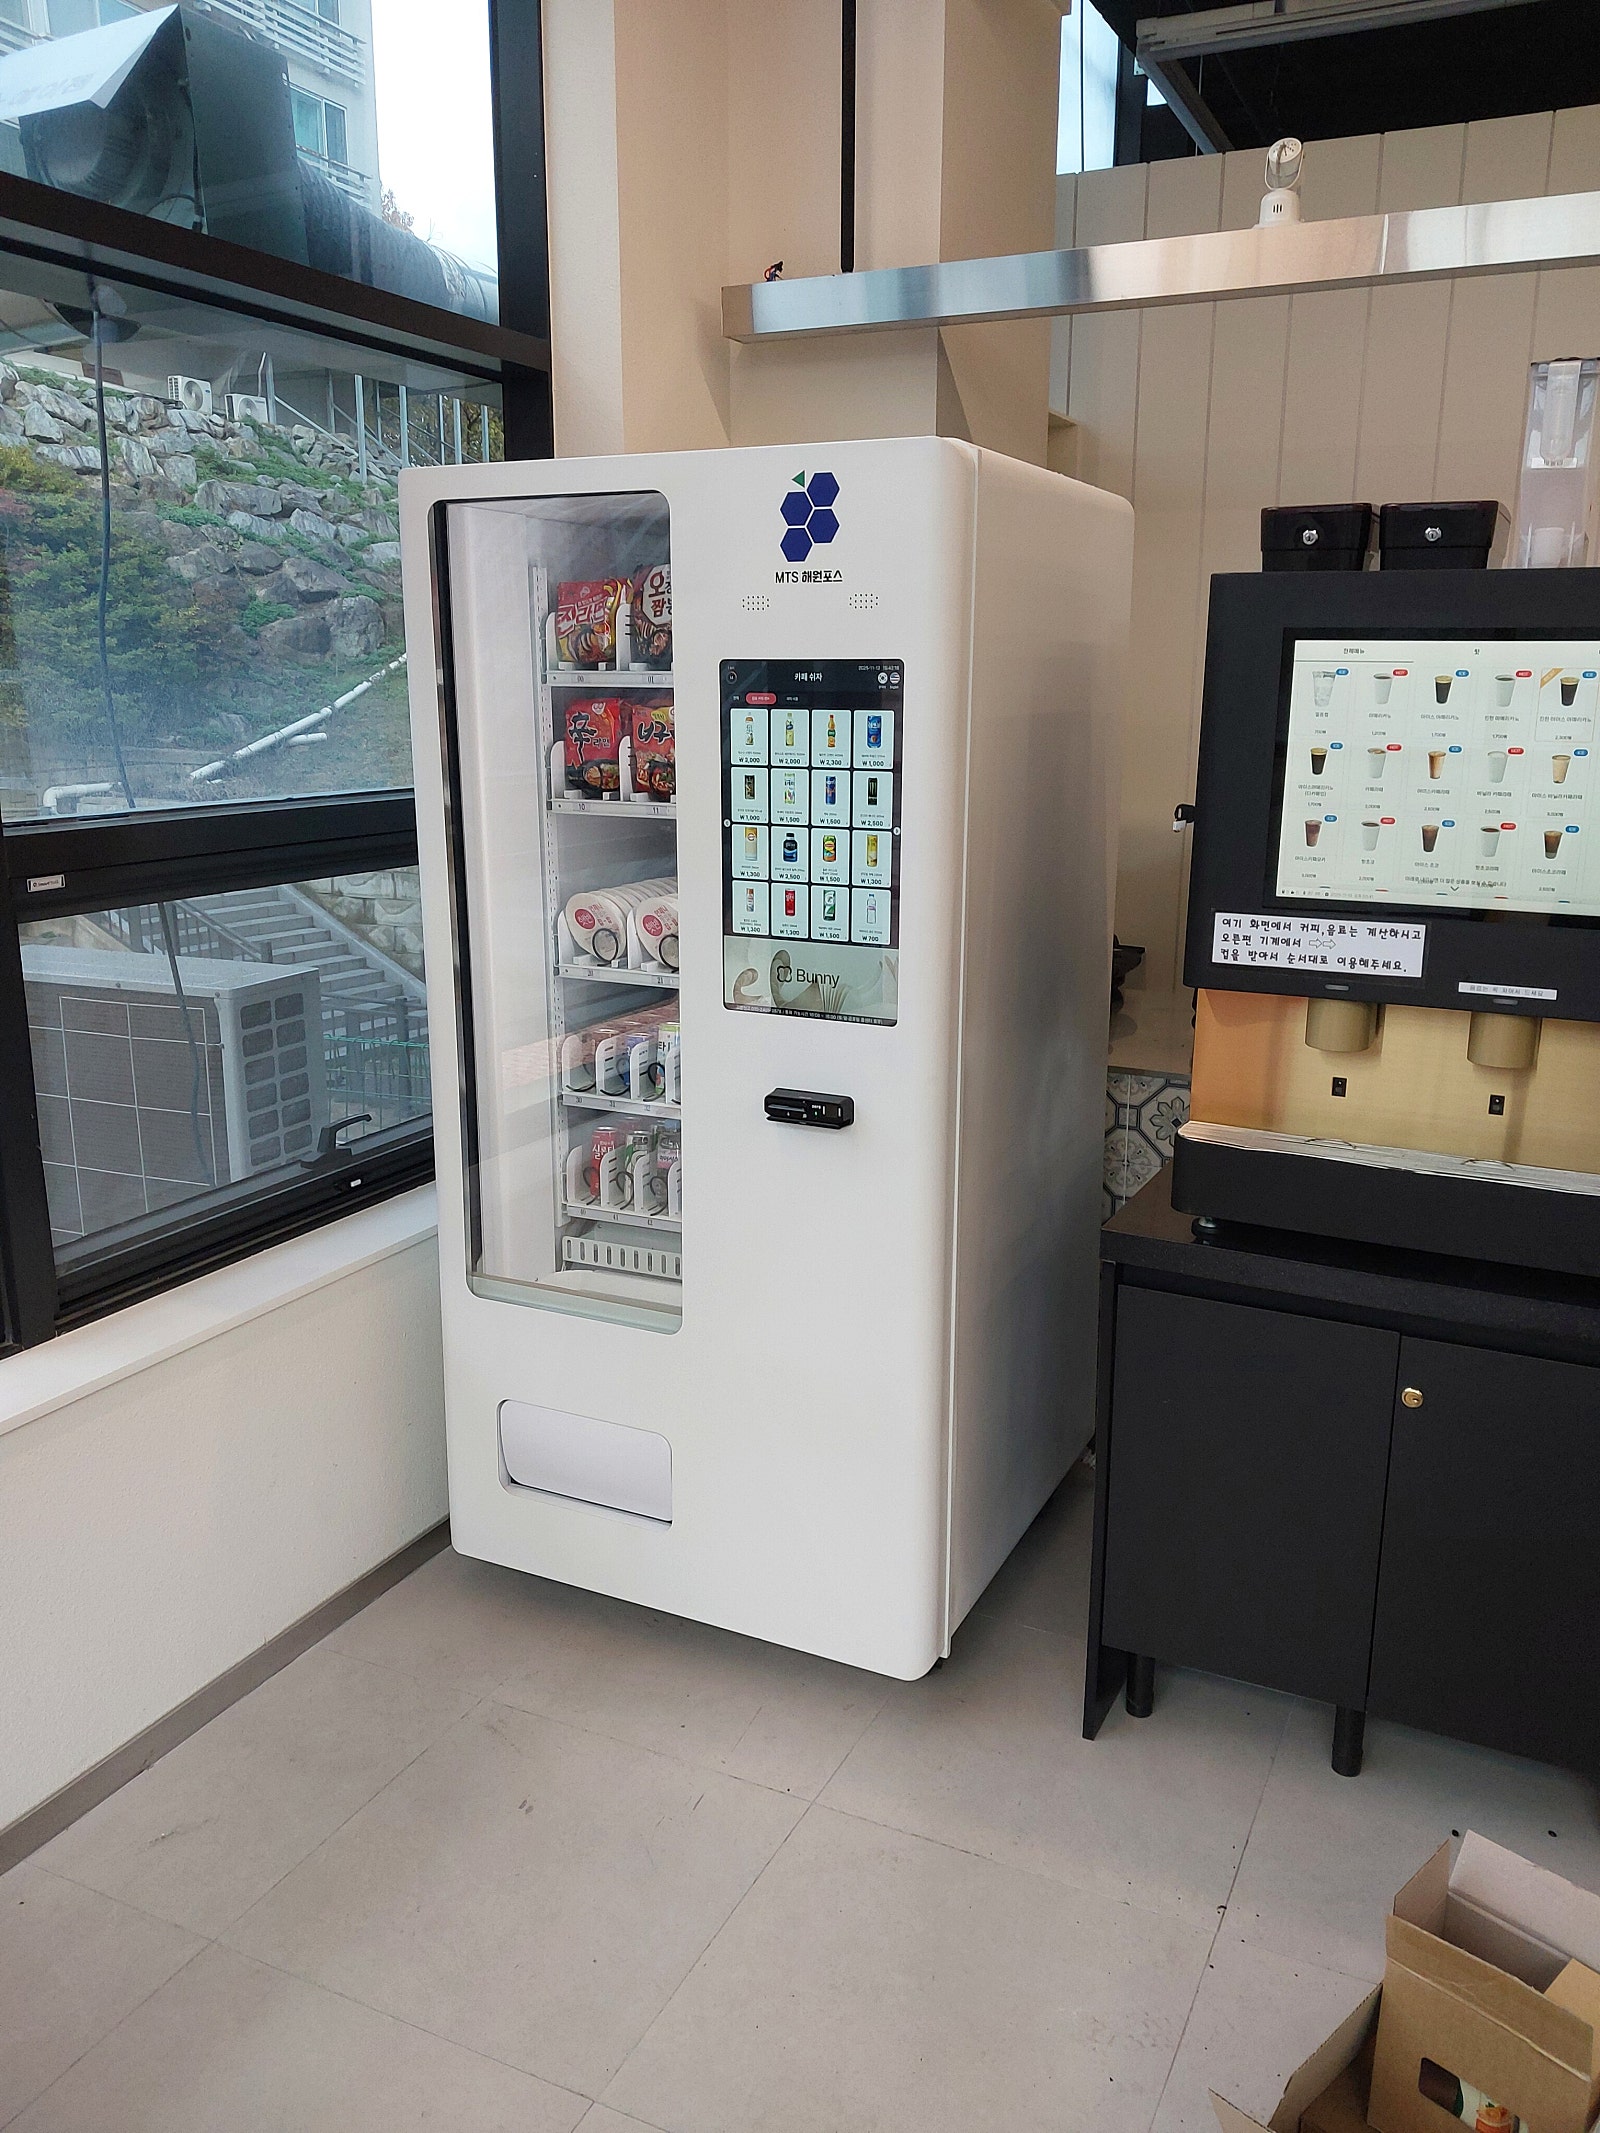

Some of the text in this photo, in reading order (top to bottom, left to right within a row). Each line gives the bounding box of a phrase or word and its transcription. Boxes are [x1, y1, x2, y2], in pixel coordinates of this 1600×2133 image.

[775, 570, 843, 584] MTS 해원포스
[637, 720, 675, 744] 너구
[1222, 918, 1242, 928] 여기
[1249, 918, 1292, 931] 화면에서
[1367, 926, 1421, 940] 계산하시고
[1221, 933, 1302, 948] 오른편 기계에서
[1247, 949, 1279, 962] 받아서
[1286, 952, 1329, 965] 순서대로
[796, 968, 840, 989] Bunny
